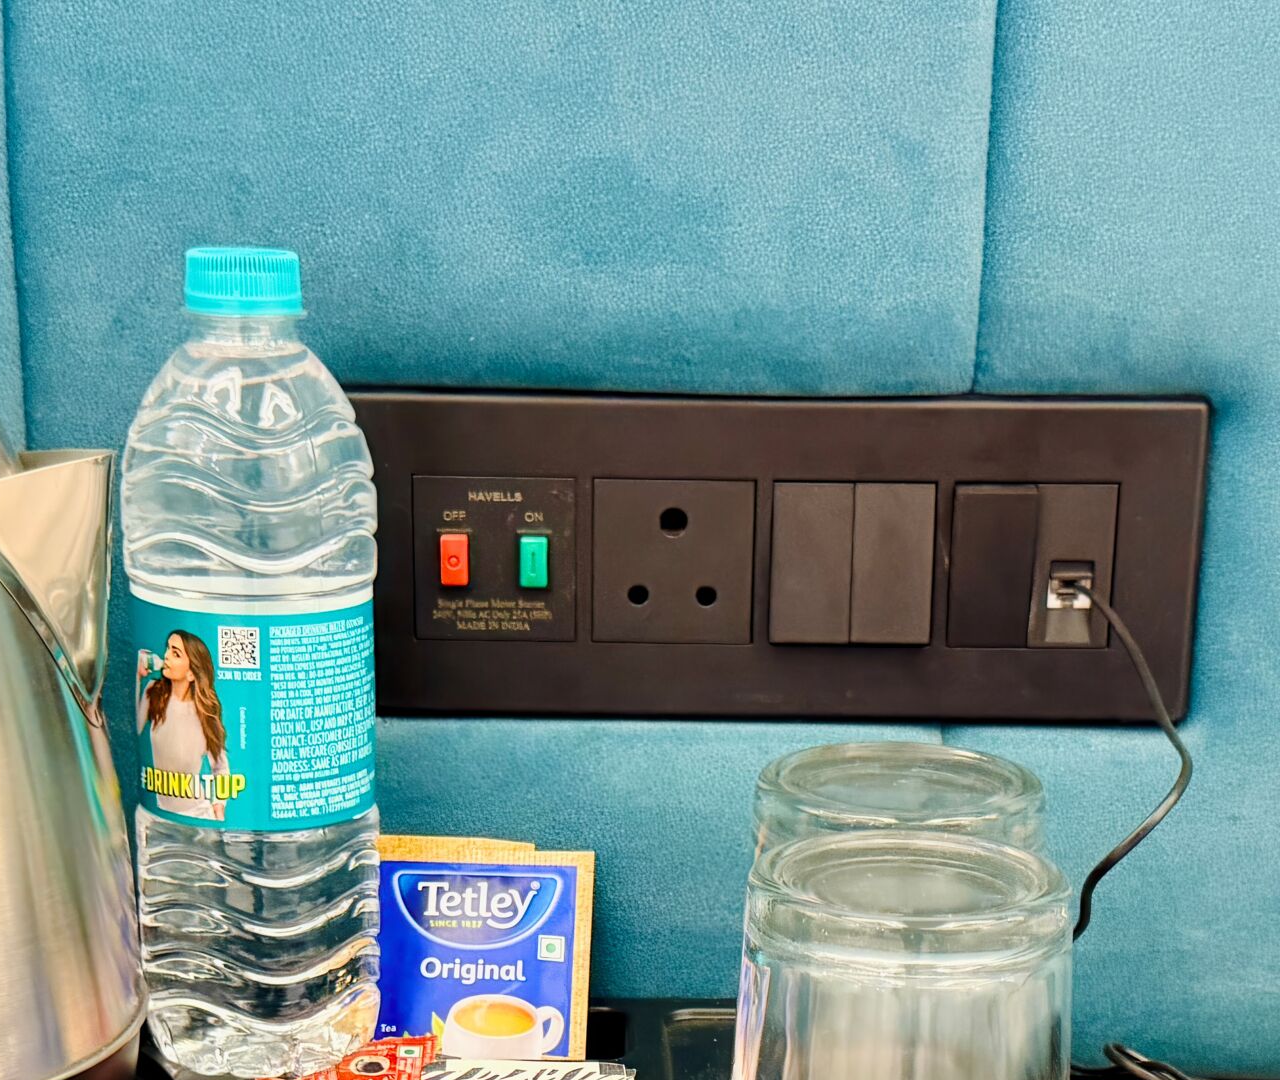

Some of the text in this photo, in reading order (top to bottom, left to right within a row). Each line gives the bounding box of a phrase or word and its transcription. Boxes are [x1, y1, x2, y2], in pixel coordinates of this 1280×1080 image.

[468, 491, 523, 502] HAVELLS
[443, 511, 466, 521] OFF
[524, 512, 543, 522] ON
[271, 708, 285, 720] FOR
[286, 708, 303, 720] DATE
[305, 707, 313, 719] OF
[271, 721, 294, 734] BATCH
[271, 734, 307, 748] CONTACT:
[308, 728, 342, 745] CUSTOMER
[271, 747, 298, 760] EMAIL:
[272, 759, 310, 774] ADDRESS:
[311, 756, 330, 769] SAME
[331, 754, 339, 767] AS
[141, 766, 246, 800] #DRINKITUP
[418, 881, 537, 929] Tetley
[429, 920, 458, 928] SINCE
[420, 957, 526, 985] Original
[380, 1024, 396, 1033] Tea
